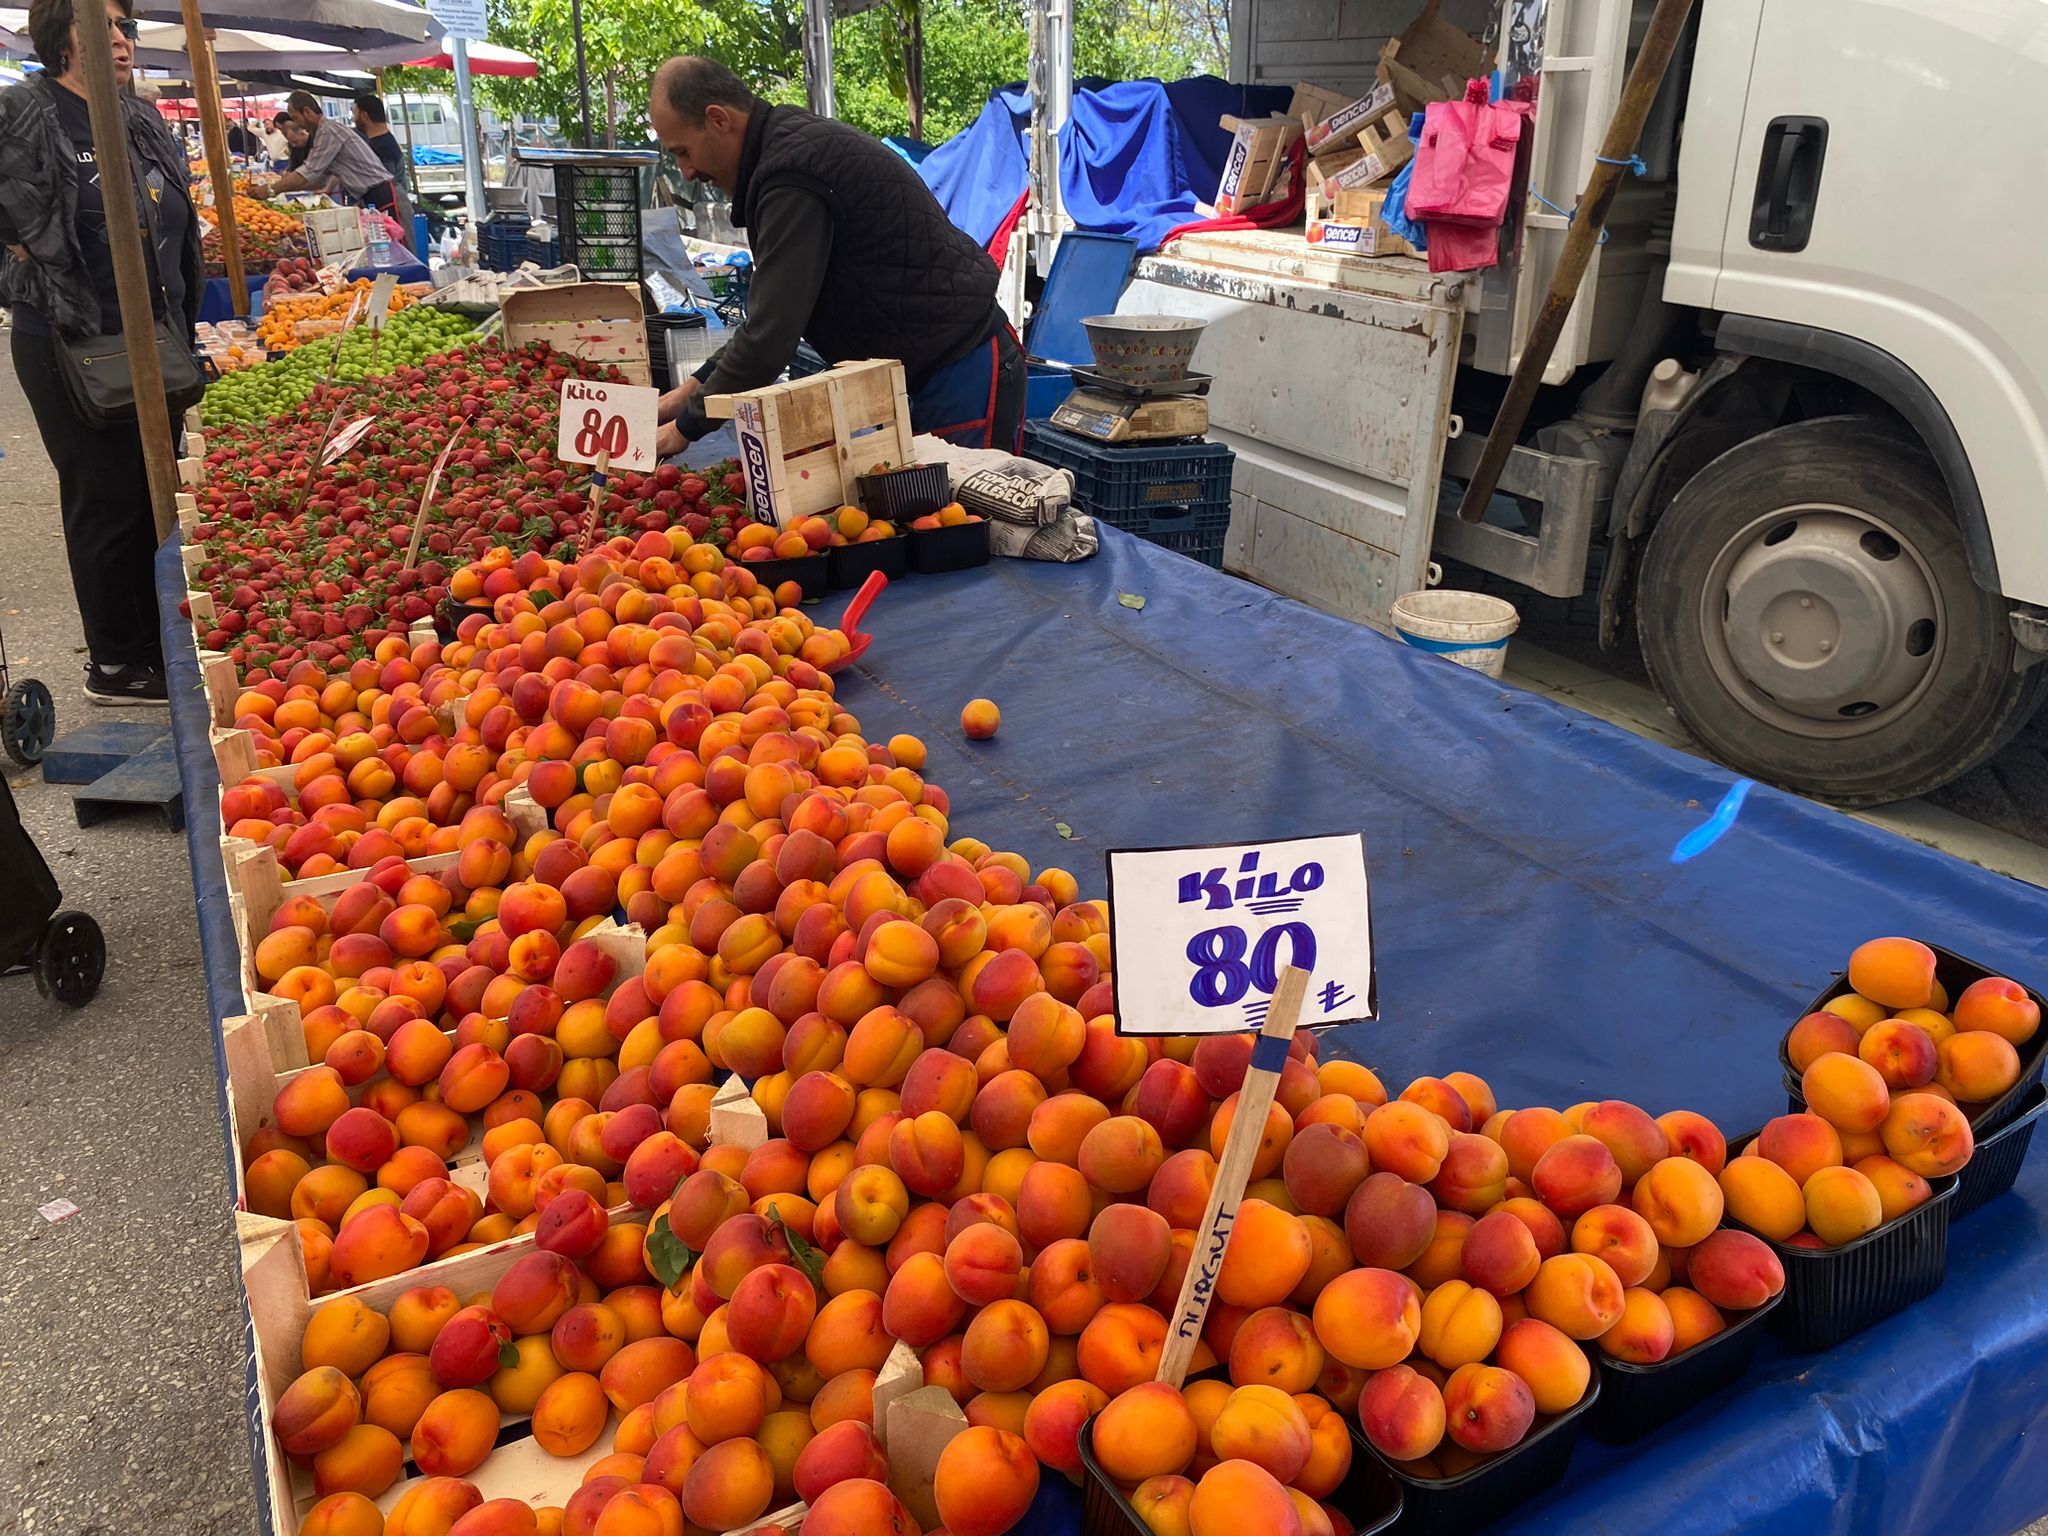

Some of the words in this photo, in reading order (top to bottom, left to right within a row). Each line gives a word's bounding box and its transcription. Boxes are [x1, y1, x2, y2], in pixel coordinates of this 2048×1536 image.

[1331, 100, 1372, 130] gencer
[1225, 146, 1246, 194] gencer
[1338, 164, 1368, 187] gencer
[1325, 228, 1359, 242] gencer
[574, 408, 629, 459] 80
[747, 438, 772, 524] gencer
[1186, 921, 1317, 1008] 80
